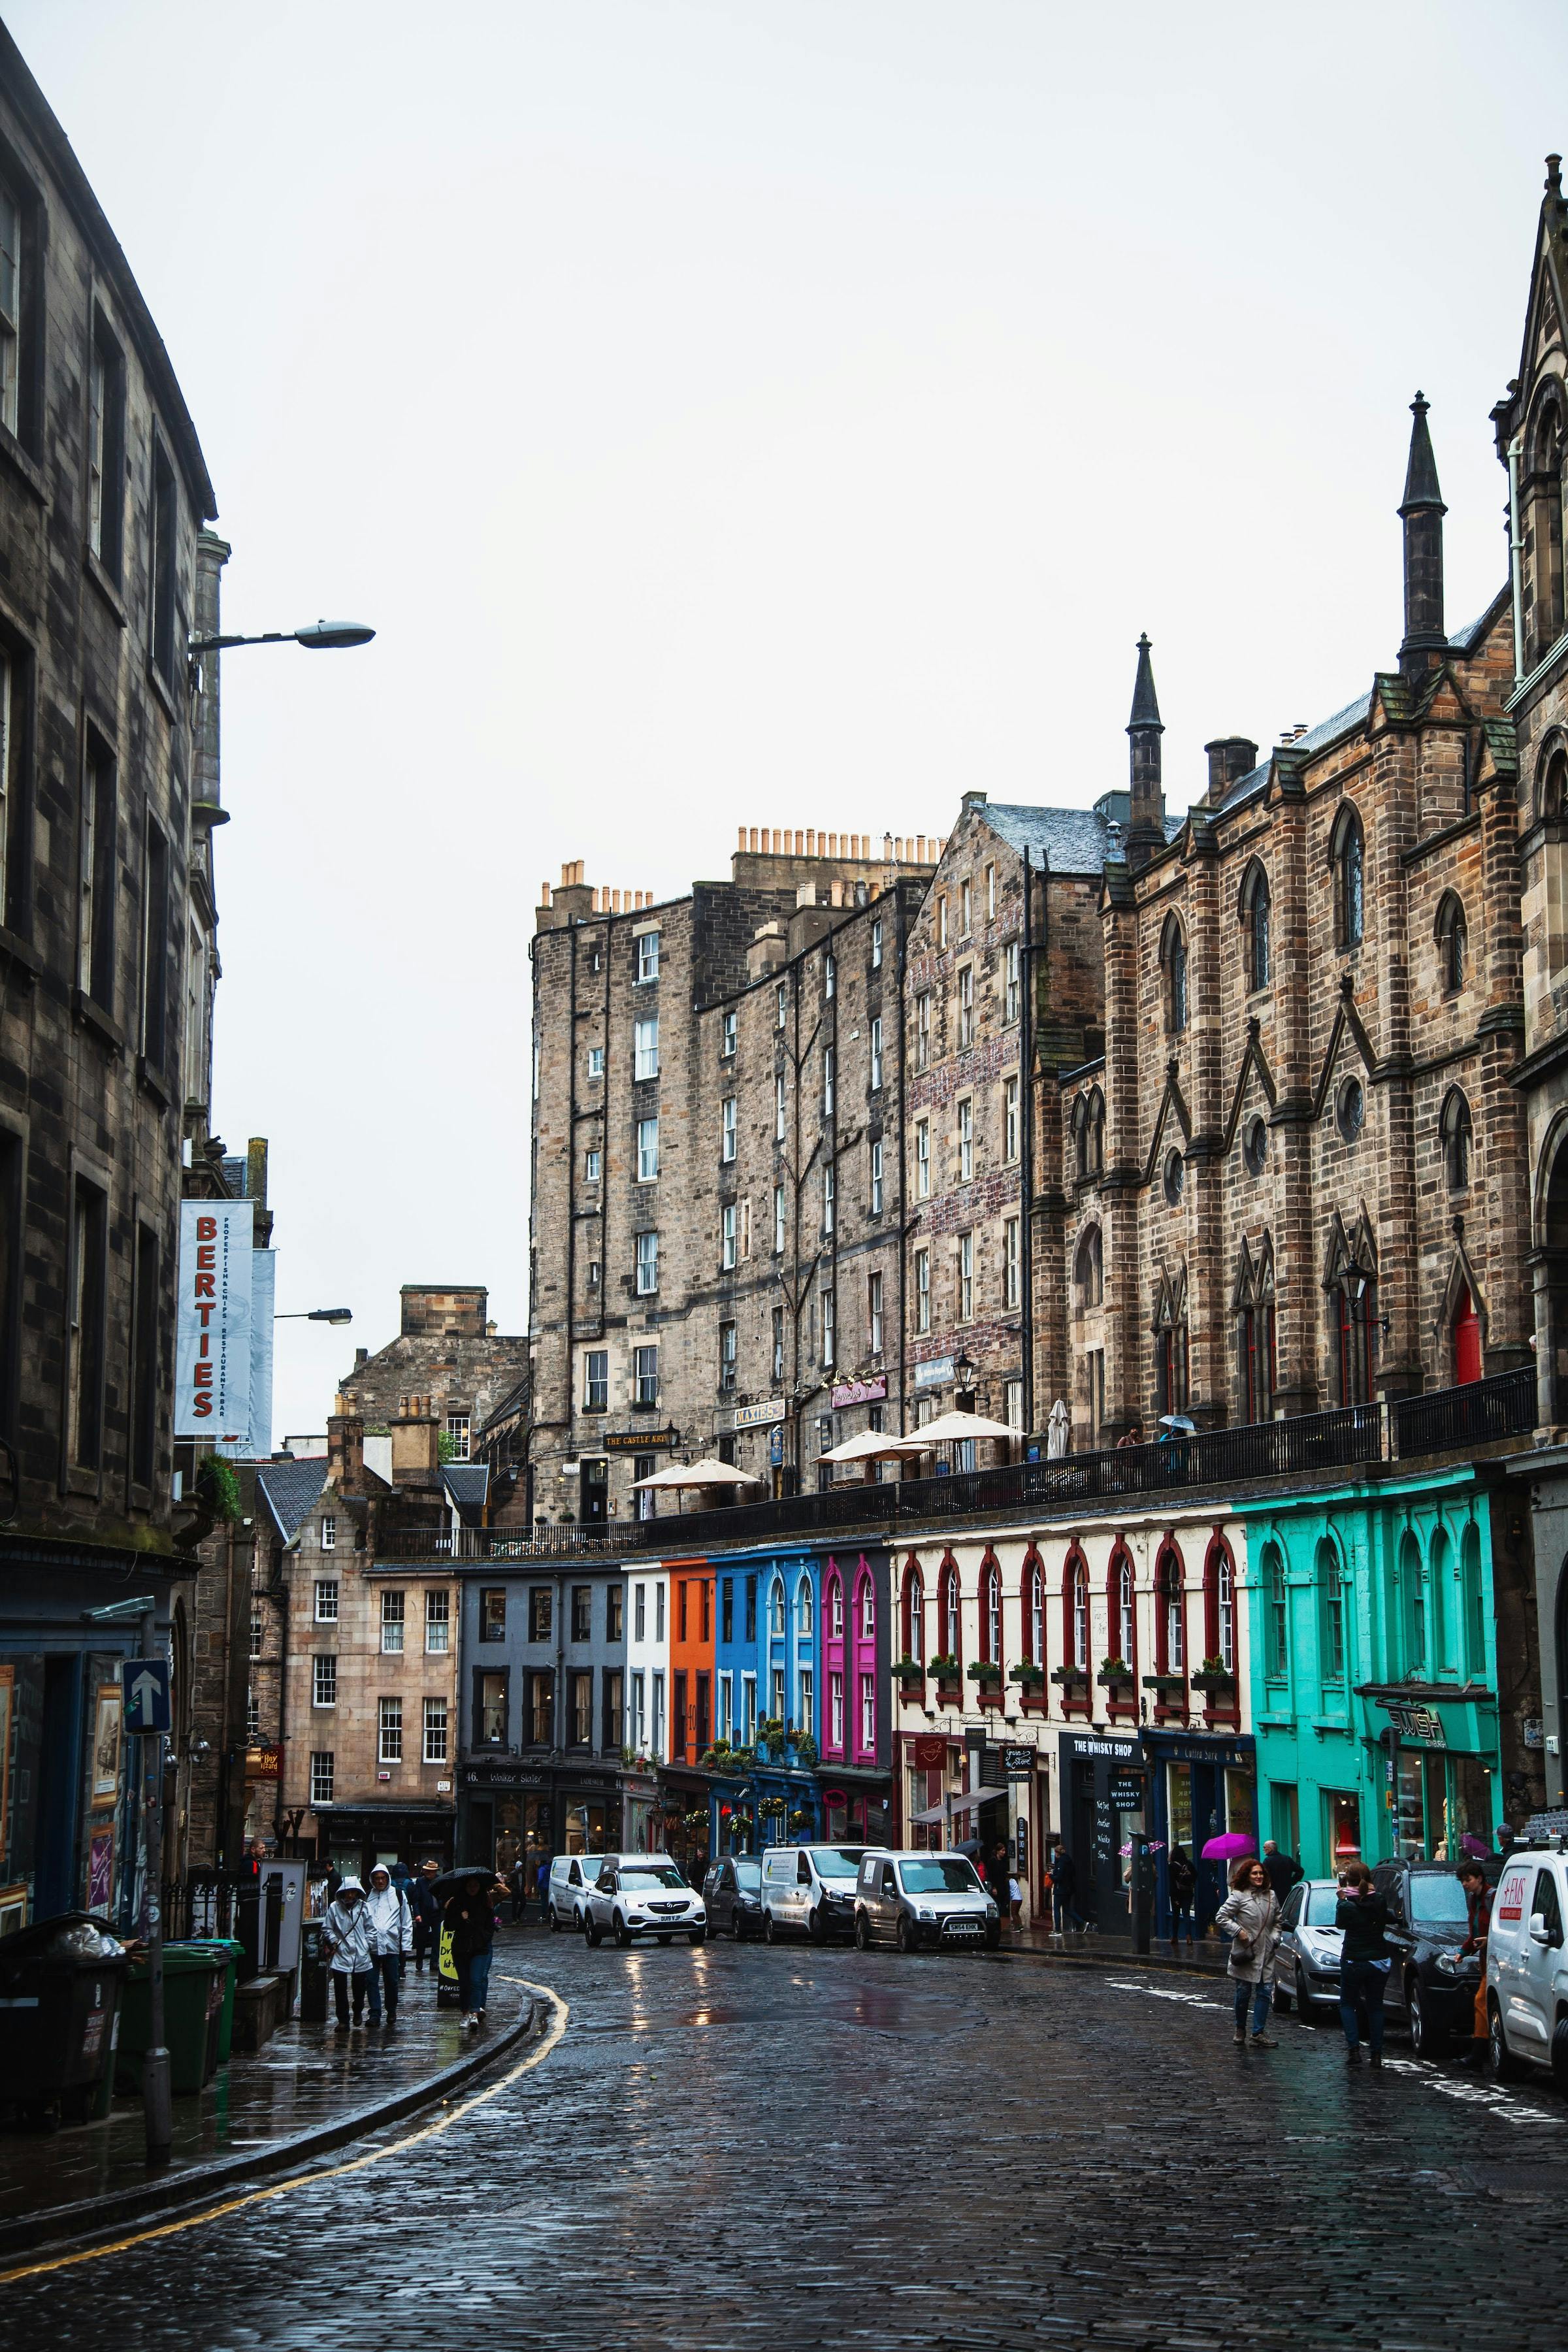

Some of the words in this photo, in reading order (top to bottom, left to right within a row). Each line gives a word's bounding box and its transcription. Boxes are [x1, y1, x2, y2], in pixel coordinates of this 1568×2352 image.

[193, 1217, 218, 1418] BERTIES
[623, 1435, 649, 1444] CASTLE
[1074, 1740, 1086, 1752] THE
[1087, 1741, 1113, 1755] WHISKY
[1115, 1743, 1132, 1757] SHOP
[490, 1772, 516, 1782] Walker
